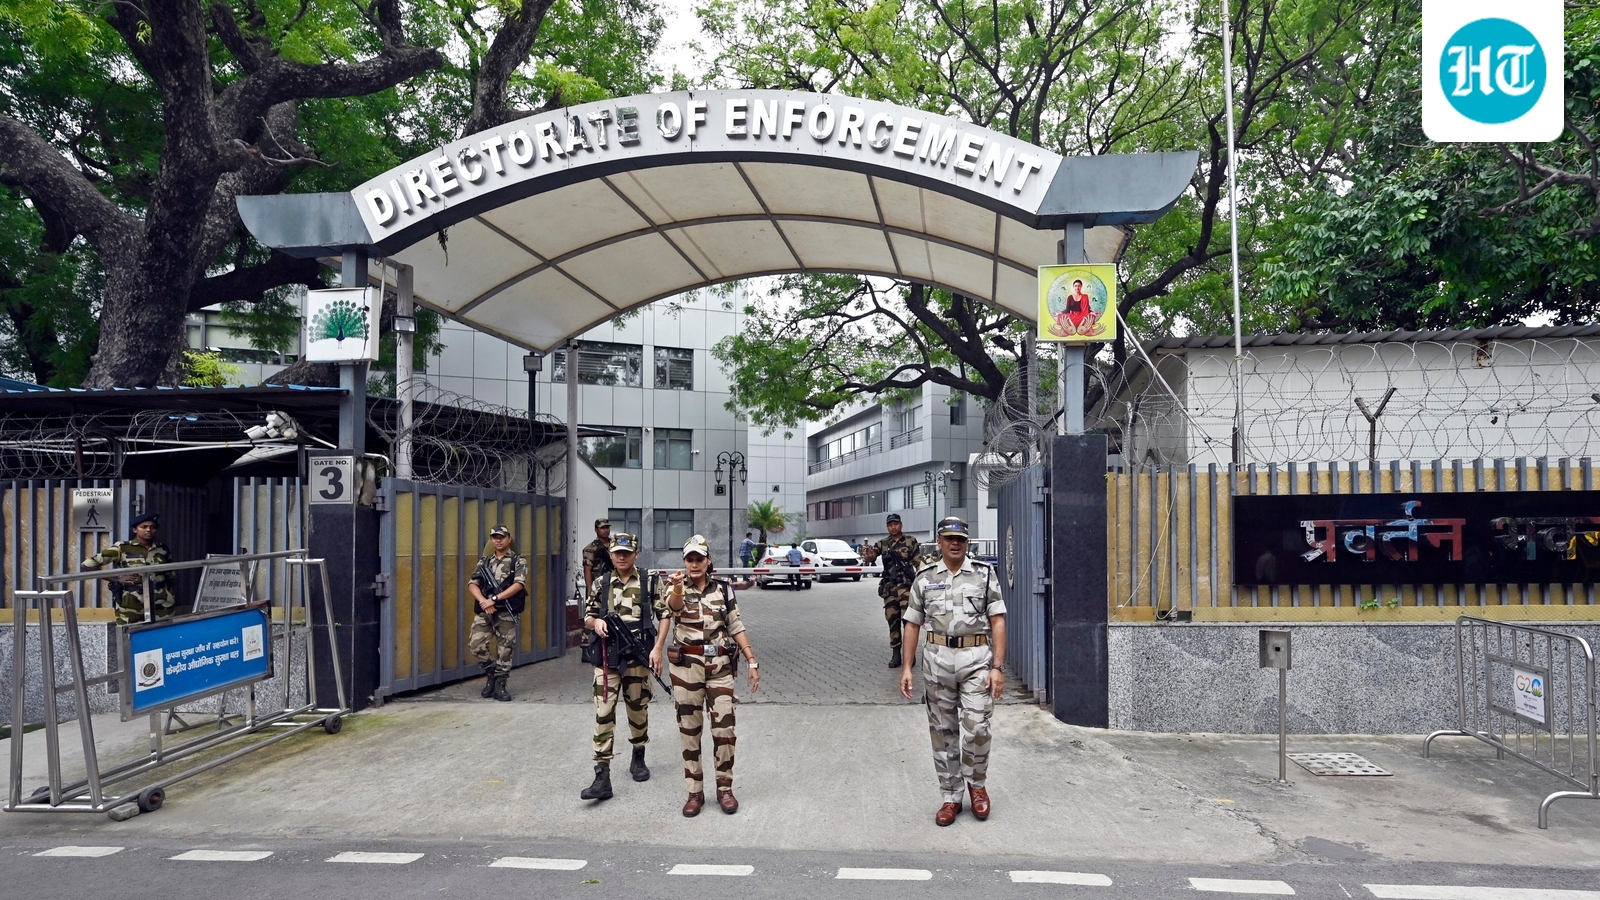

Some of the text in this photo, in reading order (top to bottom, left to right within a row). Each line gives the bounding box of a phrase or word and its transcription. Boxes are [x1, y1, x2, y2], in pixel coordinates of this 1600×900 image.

[364, 98, 1043, 227] DIRECTORATE OF ENFORCEMENT
[319, 466, 344, 500] 3
[716, 486, 724, 494] B
[1298, 500, 1466, 563] प्रवर्तन
[1516, 675, 1542, 698] G20
